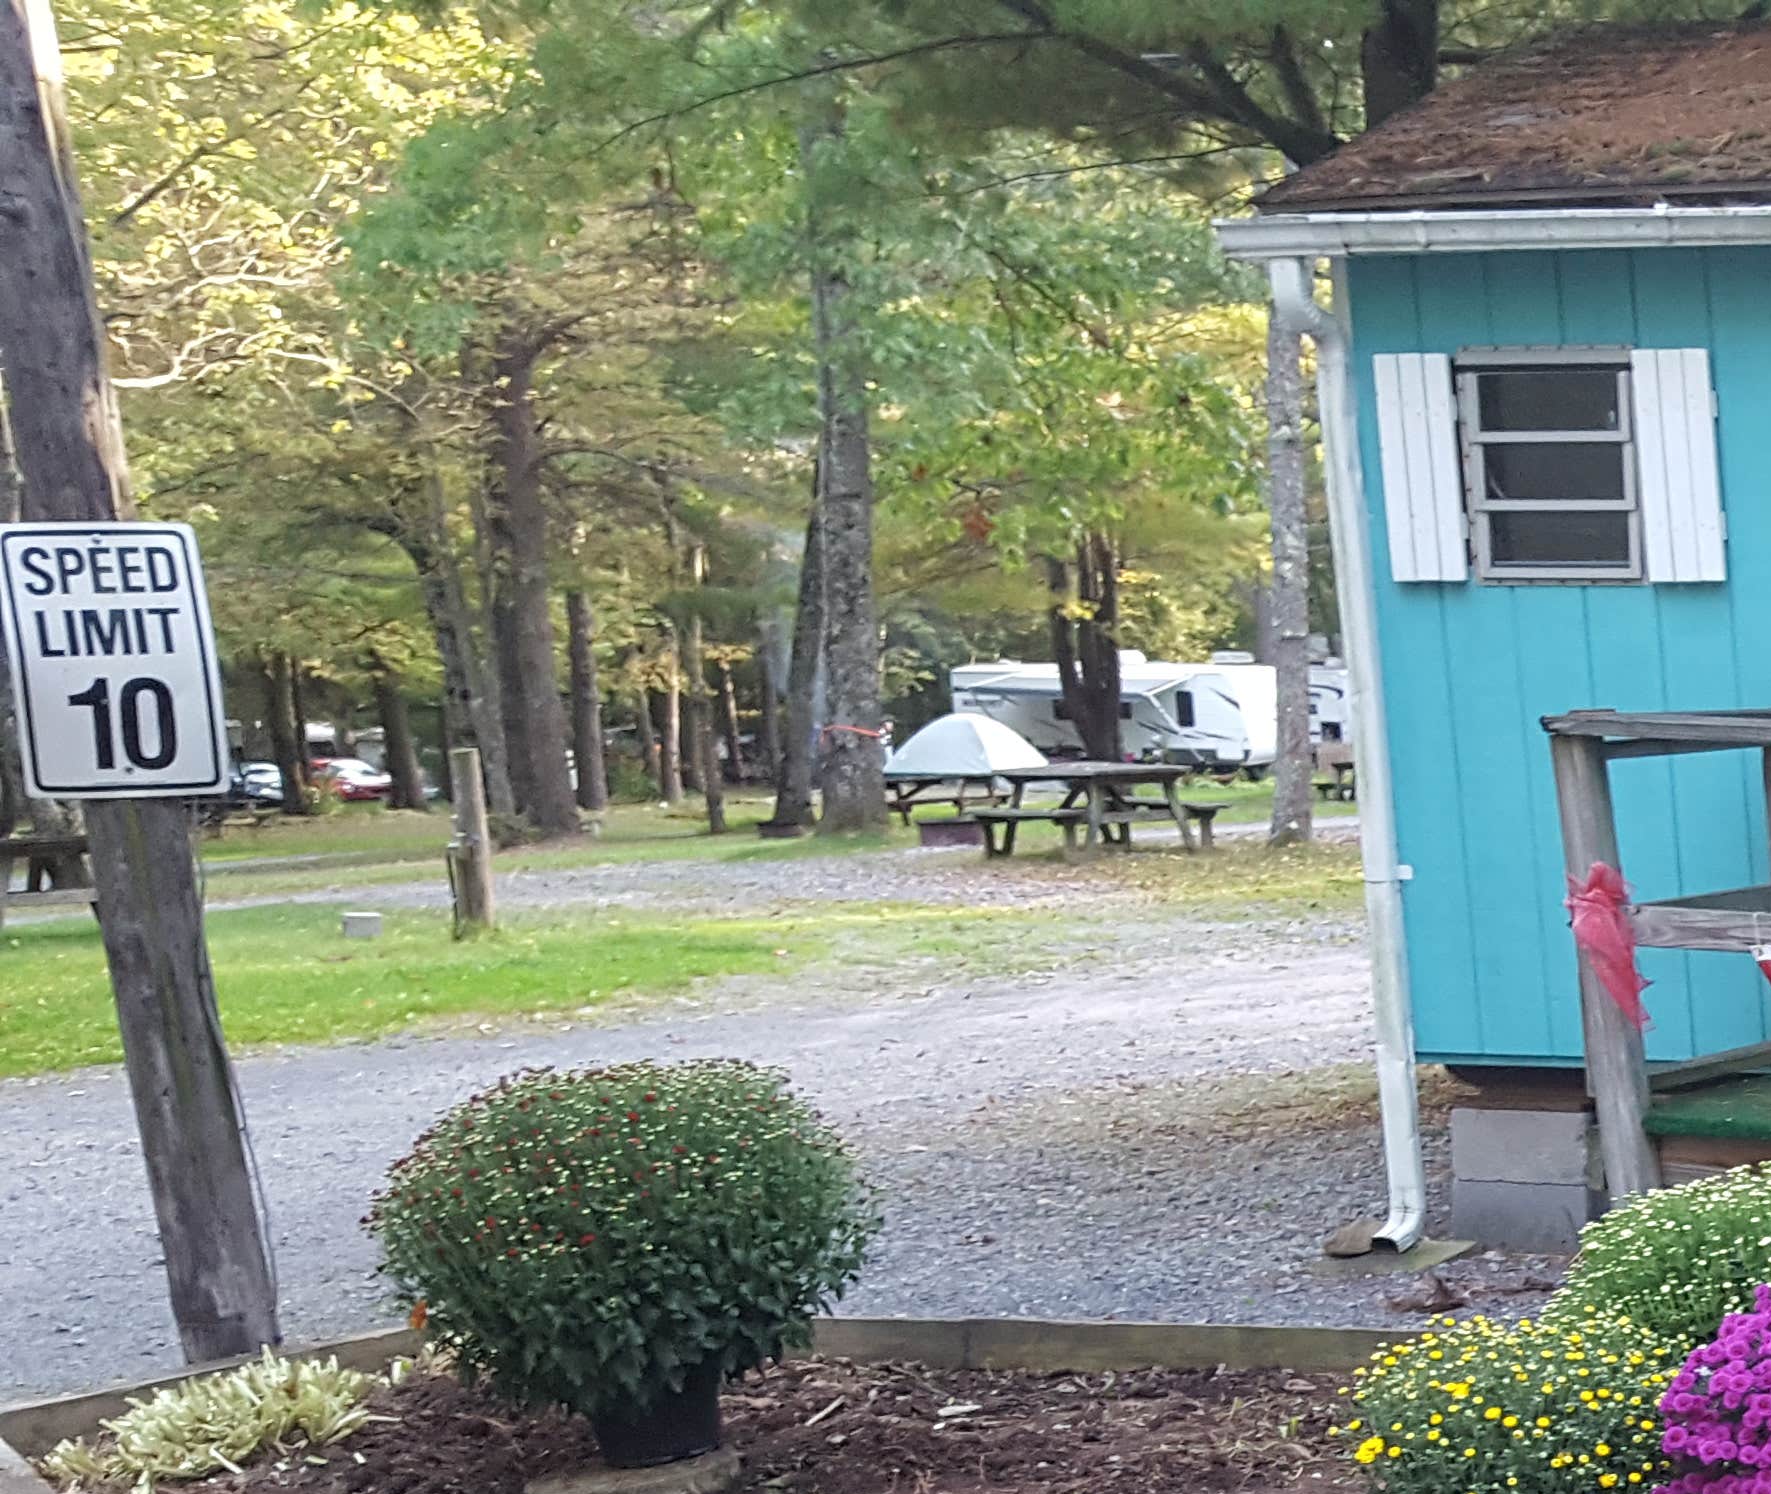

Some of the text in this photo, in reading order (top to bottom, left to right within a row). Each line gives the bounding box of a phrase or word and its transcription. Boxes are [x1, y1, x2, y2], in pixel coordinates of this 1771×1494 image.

[21, 547, 179, 596] SPEED
[34, 607, 180, 658] LIMIT
[67, 677, 178, 770] 10
